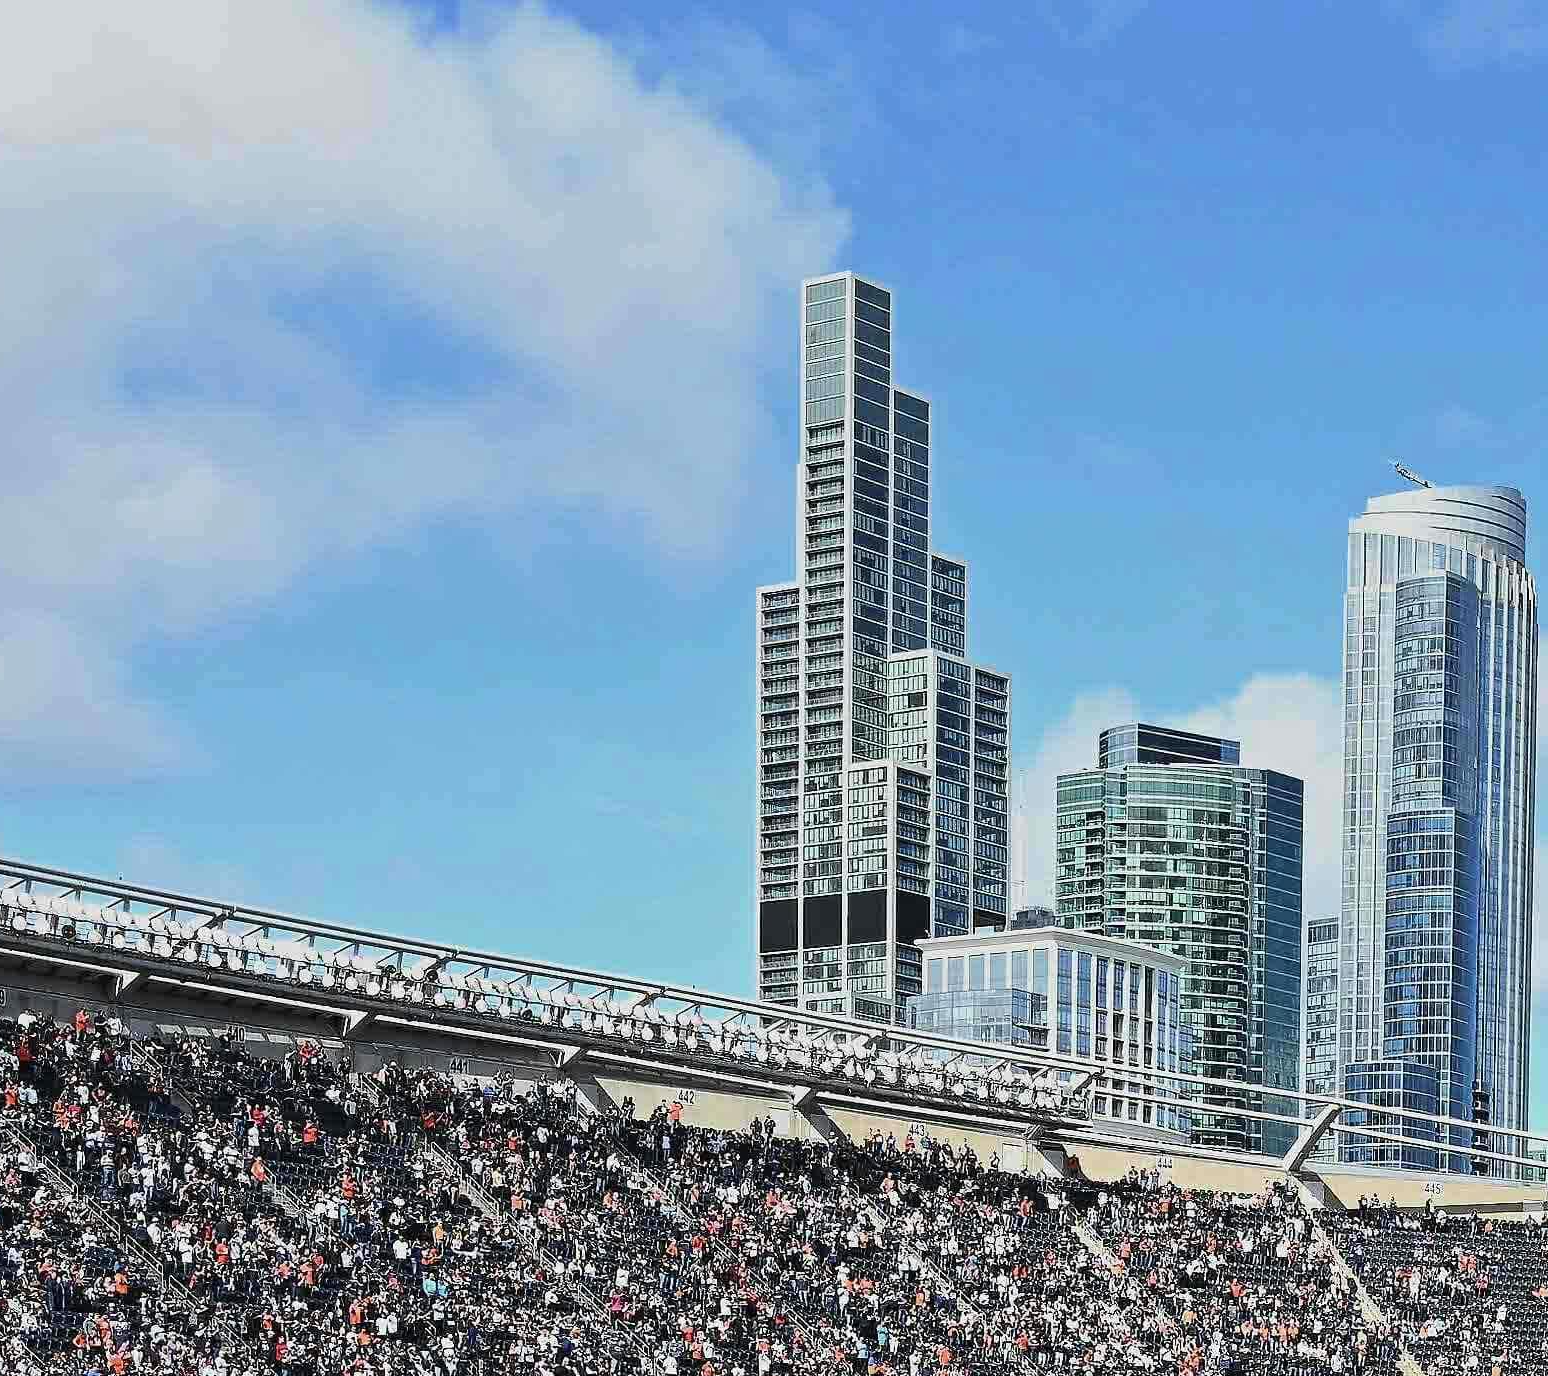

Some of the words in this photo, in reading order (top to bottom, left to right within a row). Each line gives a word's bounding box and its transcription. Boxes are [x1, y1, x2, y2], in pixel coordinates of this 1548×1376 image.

[677, 1091, 695, 1105] 442
[908, 1123, 925, 1136] 443
[1424, 1183, 1441, 1195] 445
